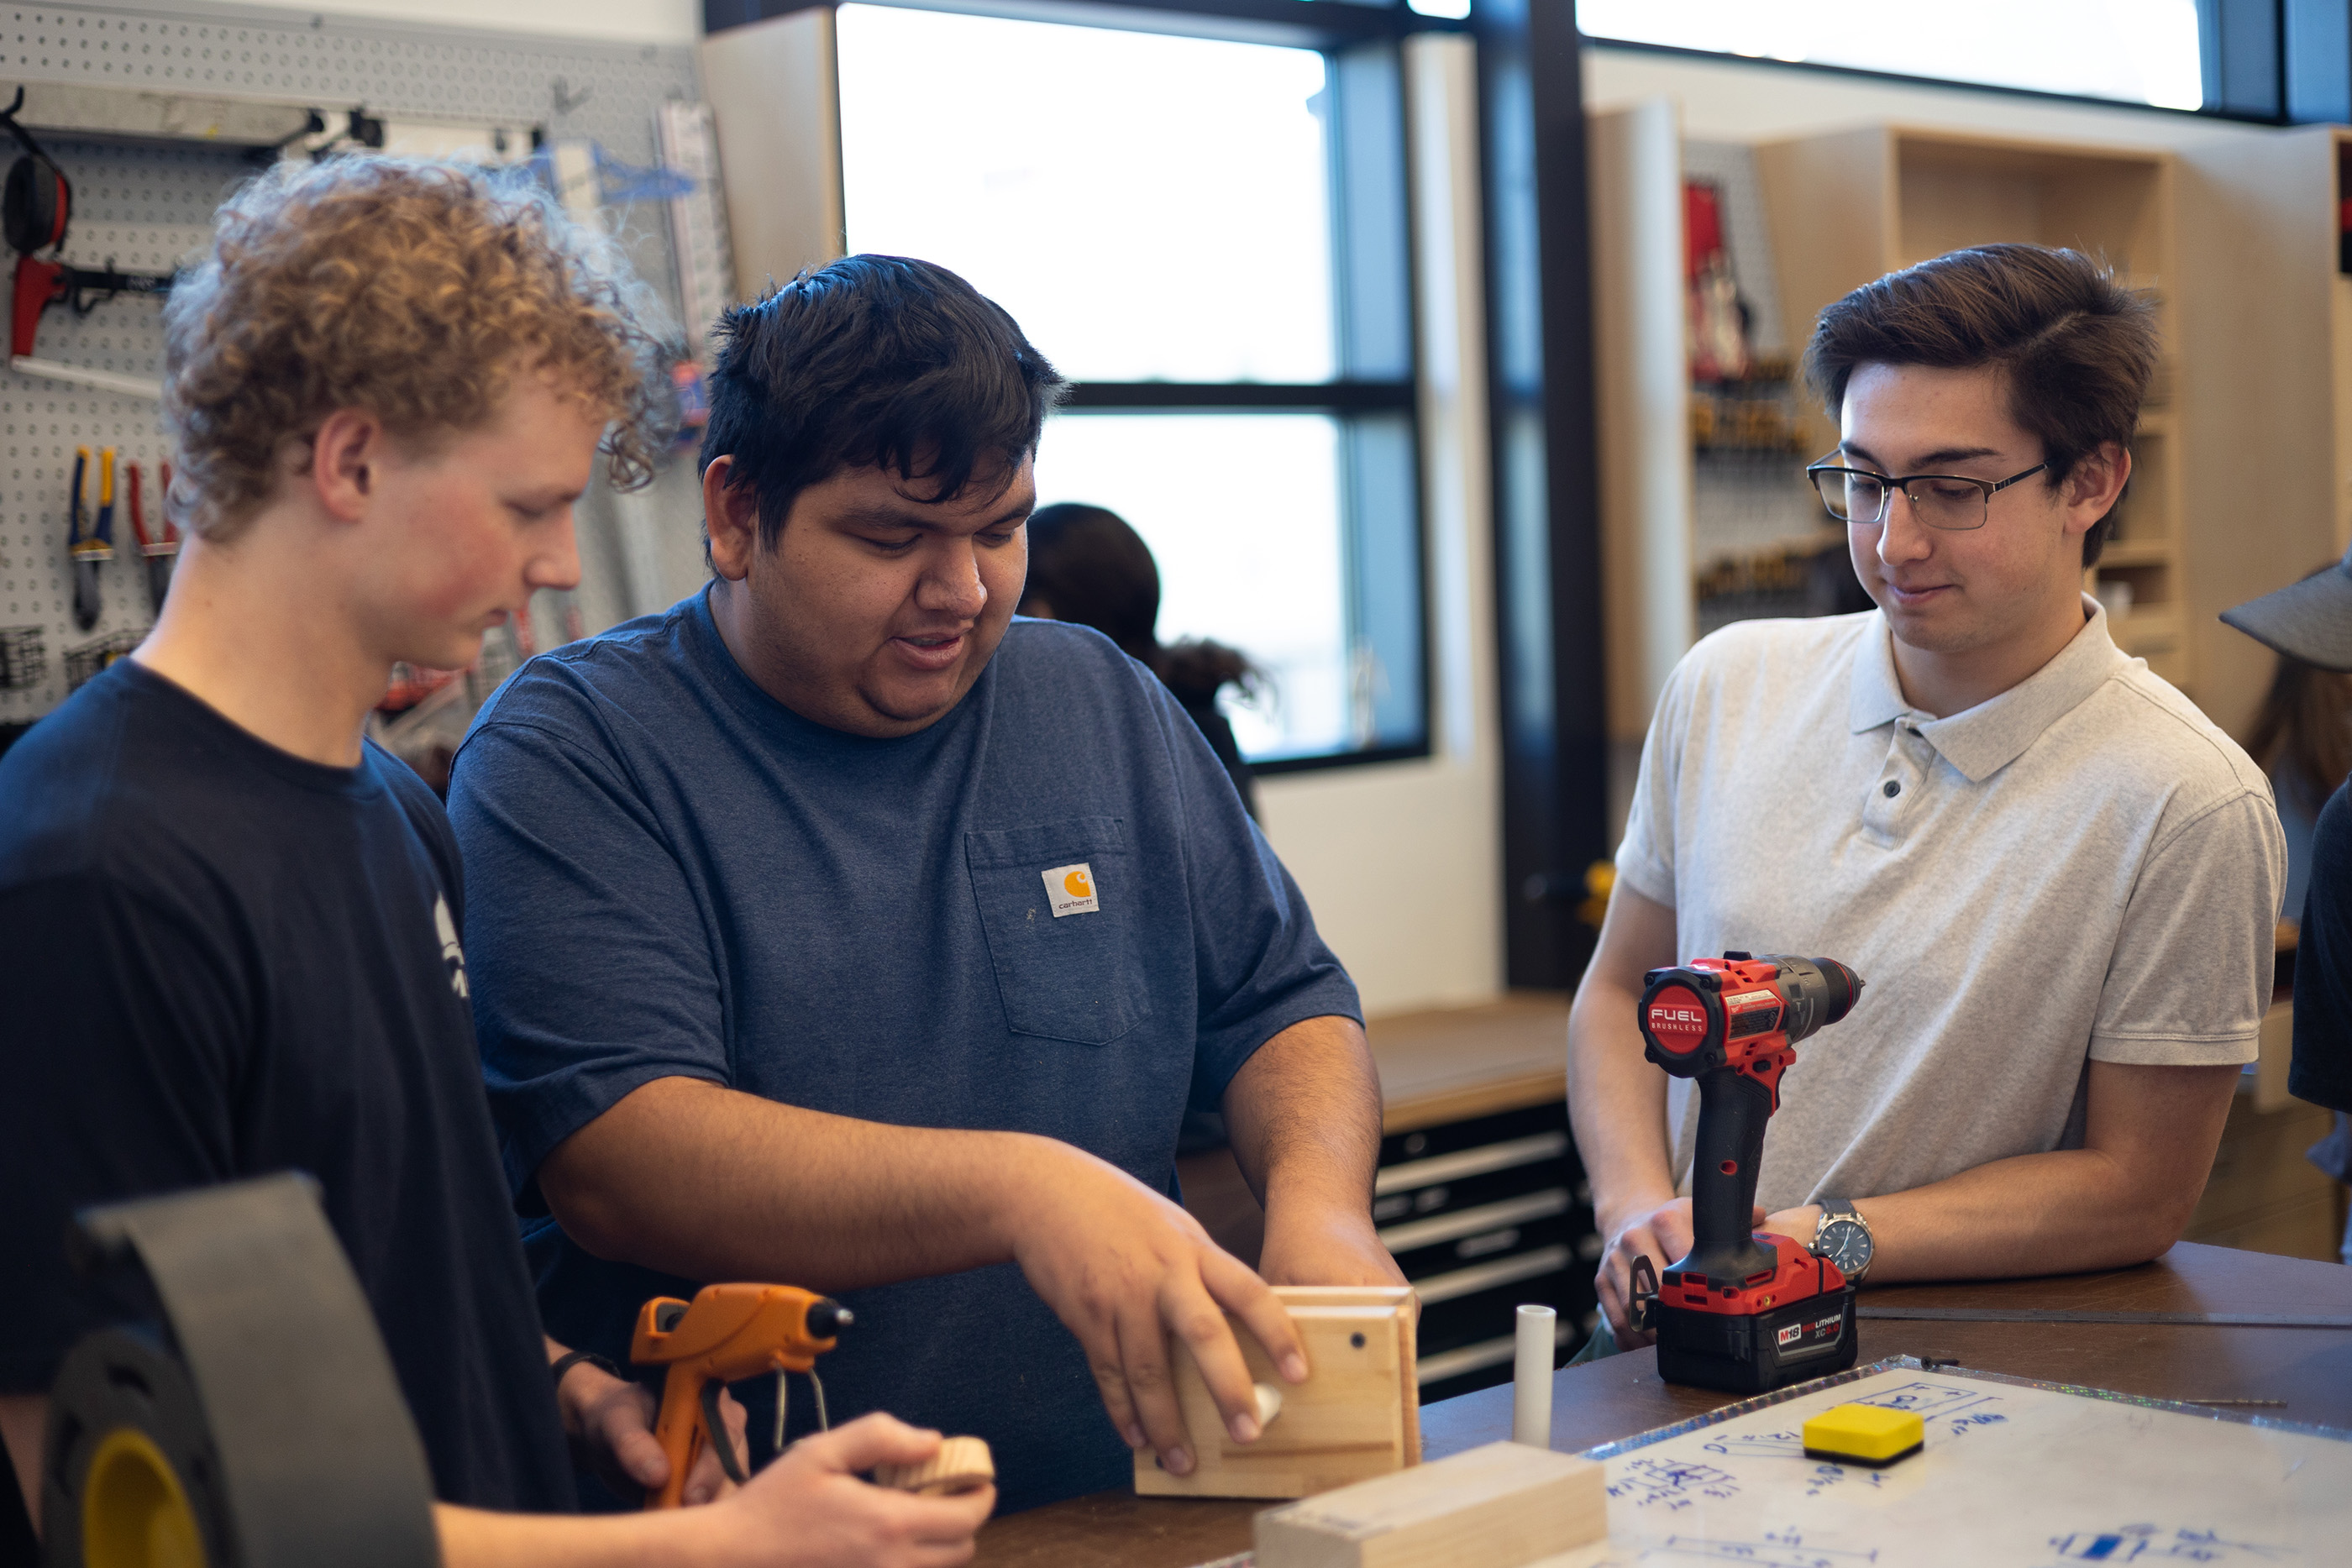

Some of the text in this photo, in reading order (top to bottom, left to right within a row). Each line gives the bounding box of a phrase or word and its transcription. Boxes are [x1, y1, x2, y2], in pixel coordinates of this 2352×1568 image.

[1058, 899, 1093, 910] carhartt
[1651, 1009, 1702, 1022] FUEL
[1651, 1022, 1703, 1032] BRUSHLESS
[1780, 1326, 1800, 1342] M18
[1815, 1323, 1840, 1339] XC5.0
